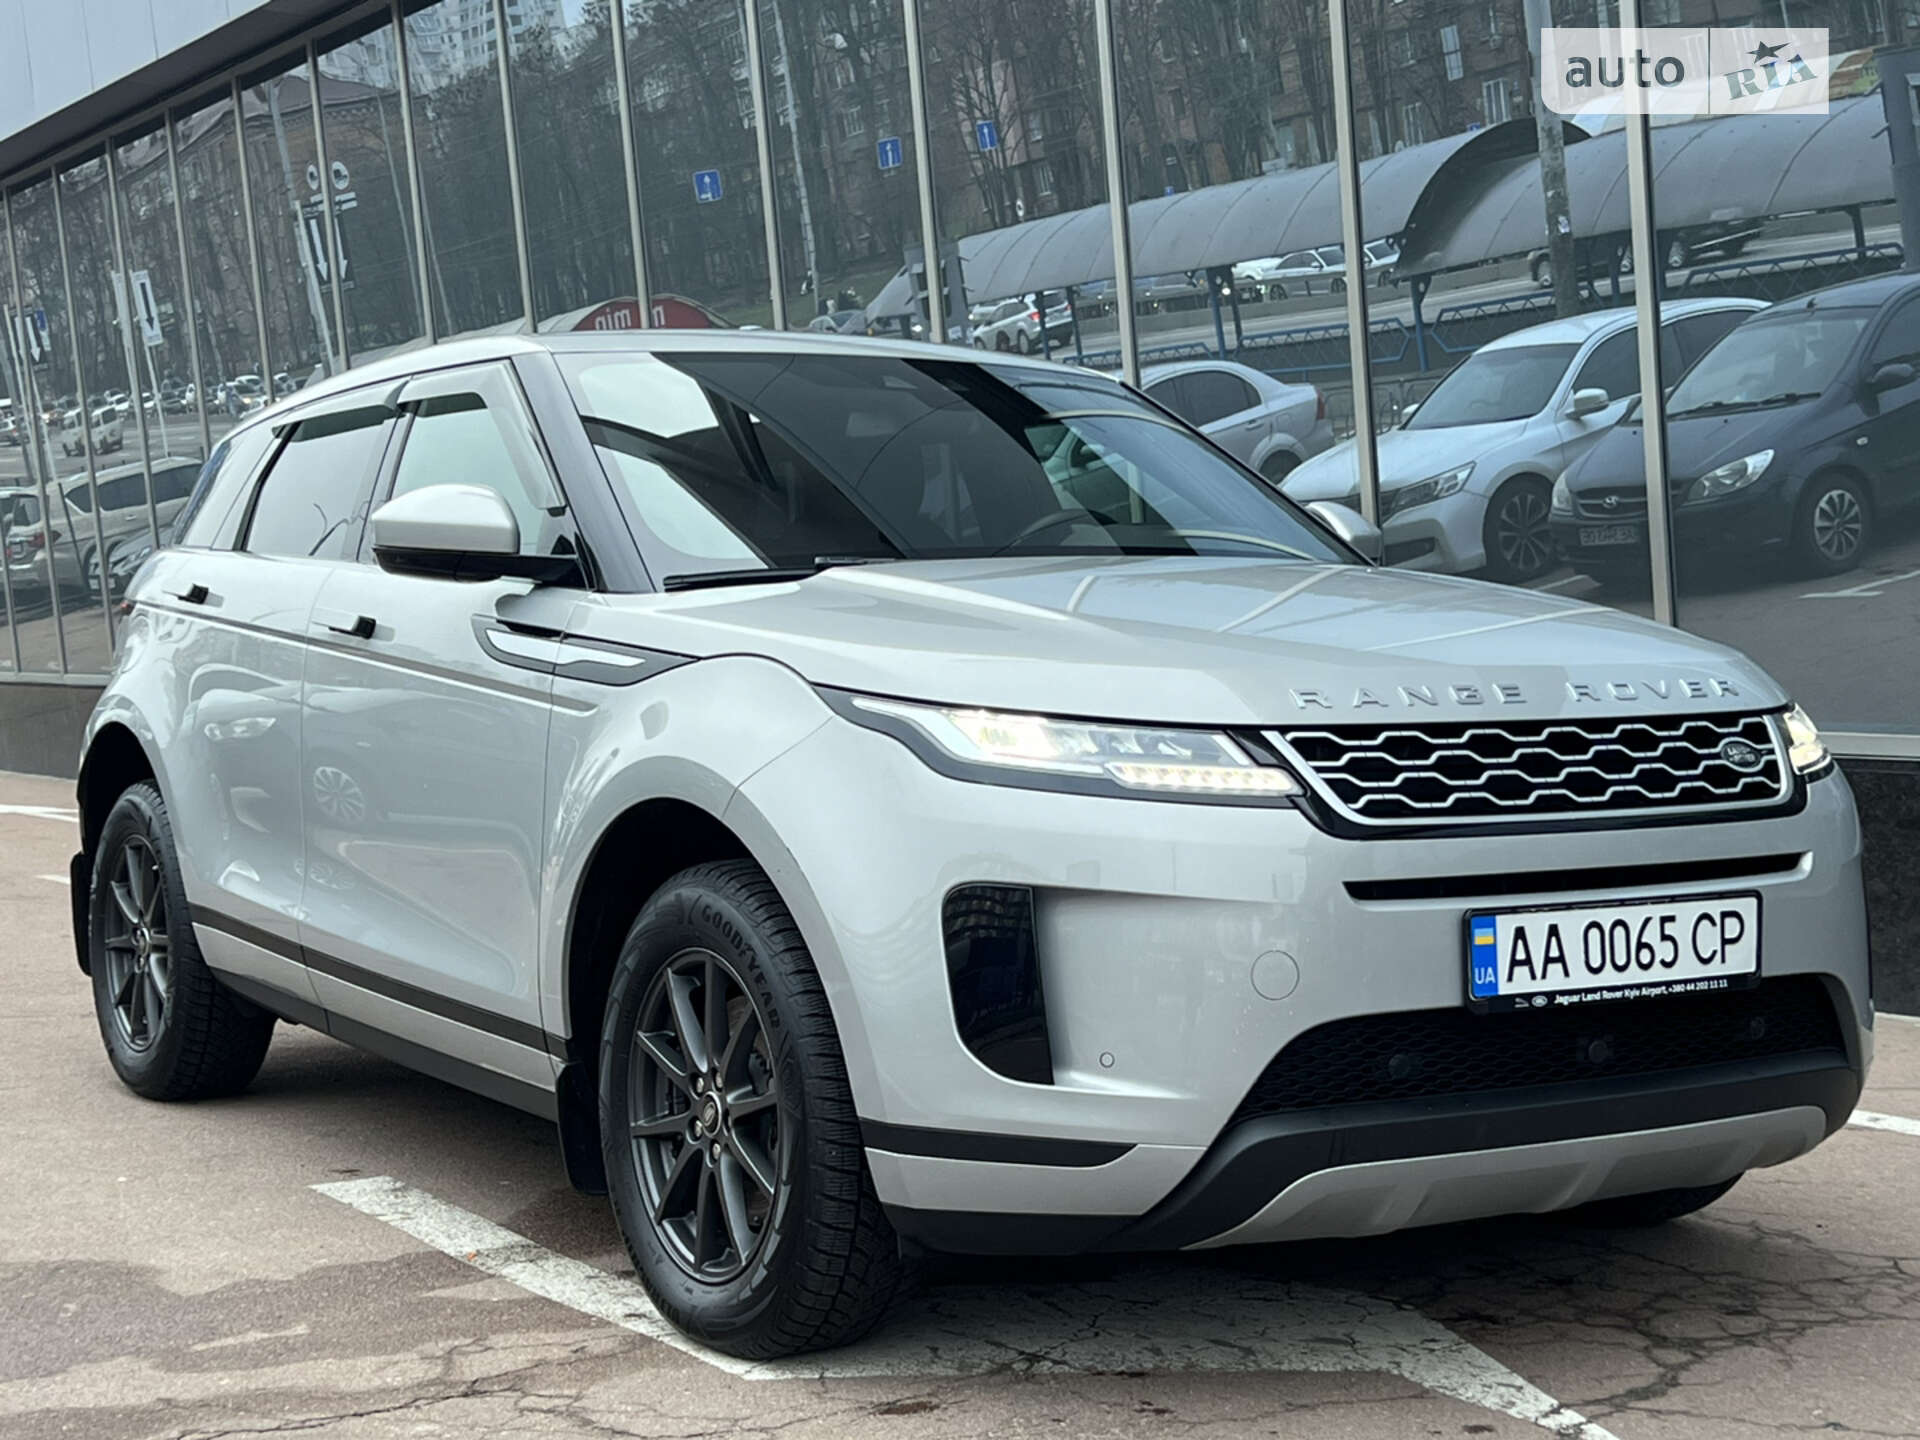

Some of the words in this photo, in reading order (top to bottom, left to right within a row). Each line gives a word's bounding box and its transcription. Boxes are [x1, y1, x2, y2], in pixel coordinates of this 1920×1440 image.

[1289, 682, 1527, 710] RANGE
[1565, 678, 1739, 702] ROVER
[1506, 924, 1570, 982] AA
[1583, 915, 1679, 975] 0065
[1691, 910, 1745, 965] CP
[702, 904, 780, 1029] GOODYEAR
[1474, 967, 1496, 985] UA
[1554, 994, 1580, 1006] Jaguar
[1581, 991, 1601, 1002] Land
[1602, 990, 1624, 1000] Rover
[1624, 988, 1640, 999] Kyiv
